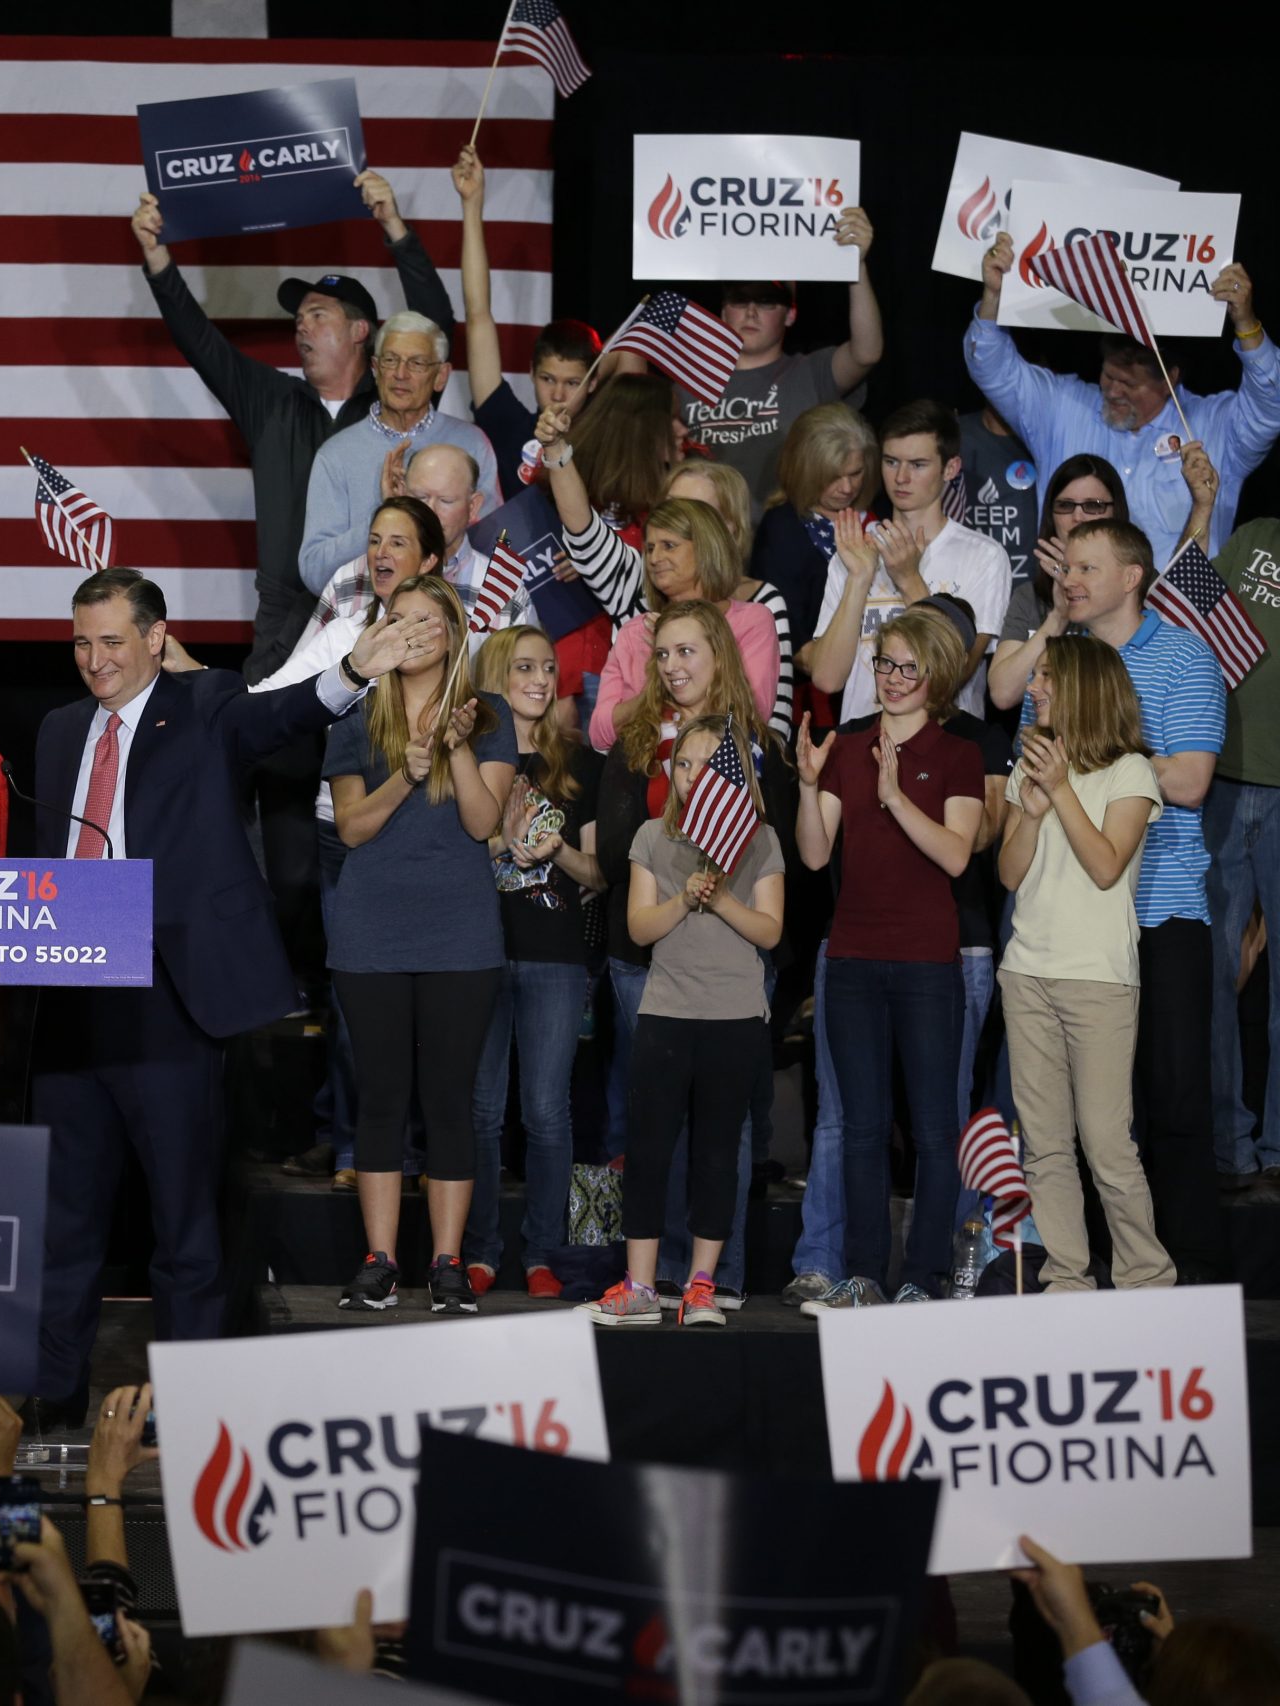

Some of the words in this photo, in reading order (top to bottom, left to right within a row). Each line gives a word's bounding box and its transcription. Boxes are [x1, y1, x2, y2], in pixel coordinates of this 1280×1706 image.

[166, 154, 235, 178] CRUZ
[258, 139, 340, 167] CARLY
[239, 174, 260, 184] 2016
[690, 176, 804, 207] CRUZ
[808, 177, 843, 207] '16
[700, 212, 840, 237] FIORINA
[1183, 234, 1216, 264] '16
[21, 871, 59, 900] '16
[35, 946, 108, 964] 55022
[954, 1271, 974, 1287] G2
[927, 1369, 1141, 1434] CRUZ
[1145, 1367, 1215, 1422] '16
[494, 1398, 570, 1457] '16
[949, 1433, 1216, 1489] FIORINA
[458, 1583, 623, 1660] CRUZ
[685, 1626, 876, 1678] CARLY
